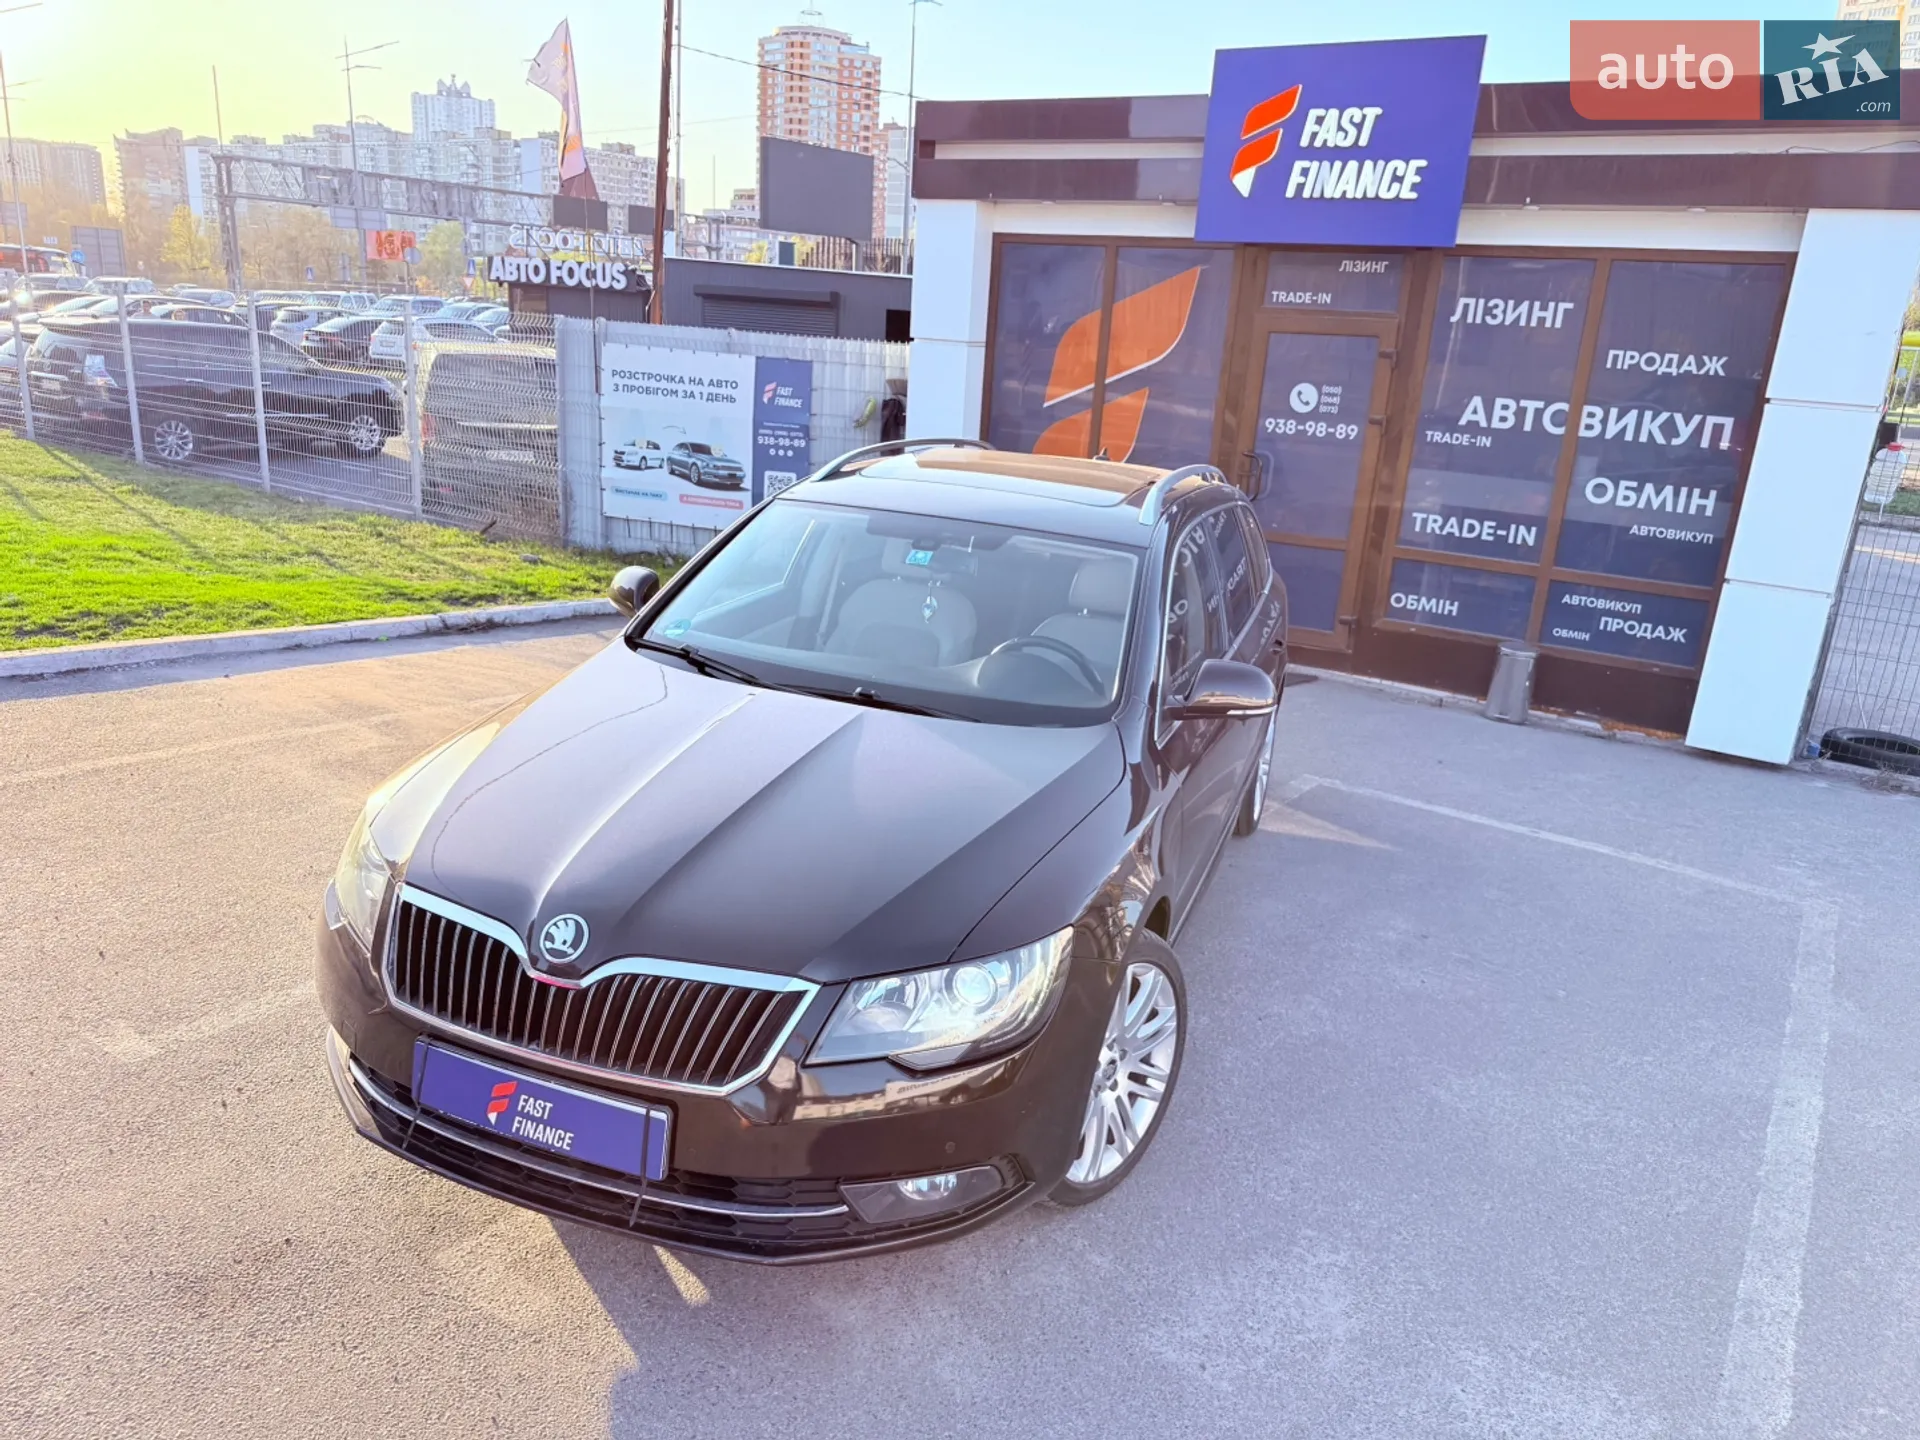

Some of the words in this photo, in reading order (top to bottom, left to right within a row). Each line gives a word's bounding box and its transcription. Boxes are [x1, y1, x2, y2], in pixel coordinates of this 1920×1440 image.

[1299, 106, 1383, 148] FAST
[1285, 158, 1428, 200] FINANCE
[489, 257, 547, 284] АВТО
[549, 259, 628, 290] FOCUS
[1338, 260, 1389, 273] ЛІЗИНГ
[1271, 291, 1332, 305] TRADE-IN
[1449, 297, 1574, 329] ЛІЗИНГ
[1605, 349, 1728, 377] ПРОДАЖ
[611, 369, 685, 385] РОЗСТРОЧКА
[688, 376, 705, 387] НА
[707, 378, 739, 390] АВТО
[622, 384, 679, 398] ПРОБІГОМ
[681, 389, 696, 400] ЗА
[698, 391, 704, 401] 1
[705, 392, 737, 404] ДЕНЬ
[1264, 418, 1359, 440] 938-98-89
[1458, 395, 1735, 451] АВТОВИКУП
[757, 435, 806, 448] 938-98-89
[1425, 430, 1492, 448] TRADE-IN
[1584, 476, 1718, 517] ОБМІН
[1411, 512, 1537, 547] TRADE-IN
[1629, 524, 1714, 545] АВТОВИКУП
[1389, 592, 1459, 617] ОБМІН
[1561, 593, 1642, 615] АВТОВИКУП
[1552, 627, 1590, 642] ОБМІН
[1599, 616, 1687, 644] ПРОДАЖ
[517, 1094, 553, 1120] FAST
[511, 1116, 574, 1151] FINANCE
